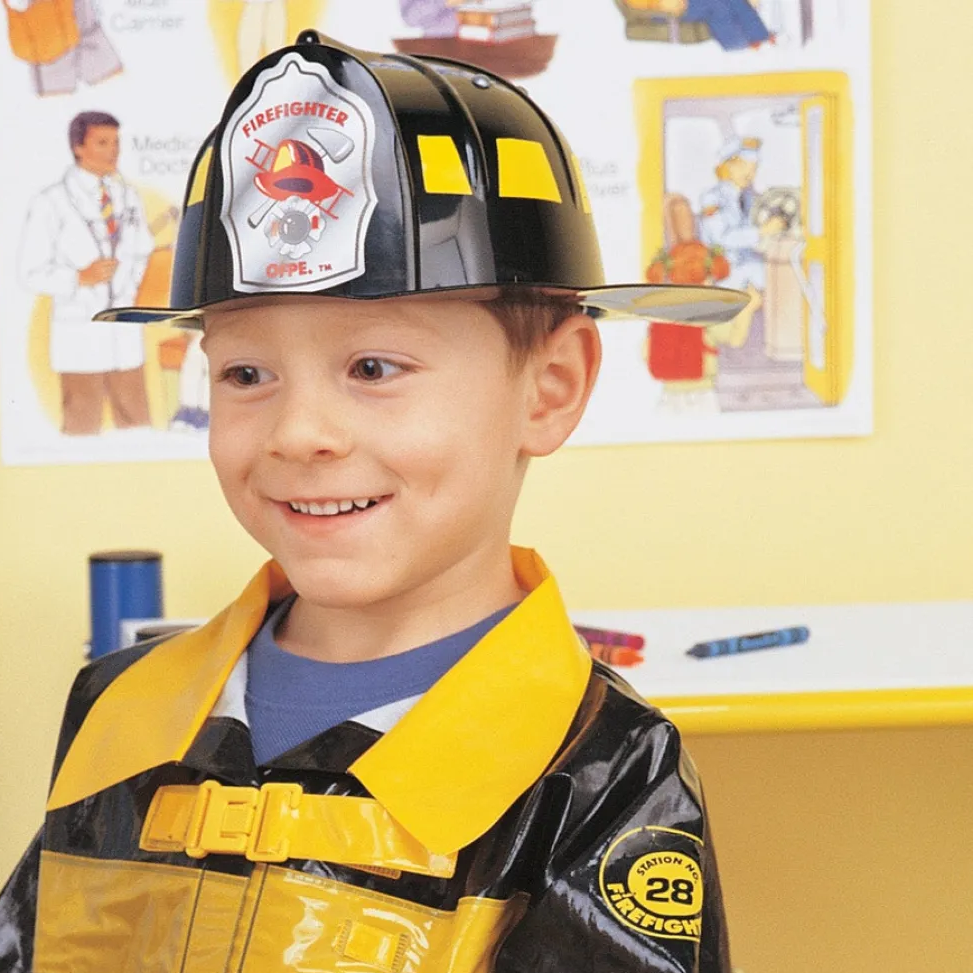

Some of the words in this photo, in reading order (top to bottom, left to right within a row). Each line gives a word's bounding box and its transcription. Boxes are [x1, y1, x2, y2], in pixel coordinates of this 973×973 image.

[242, 102, 349, 138] FIREFIGHTER
[636, 856, 683, 876] STATION
[645, 877, 694, 906] 28
